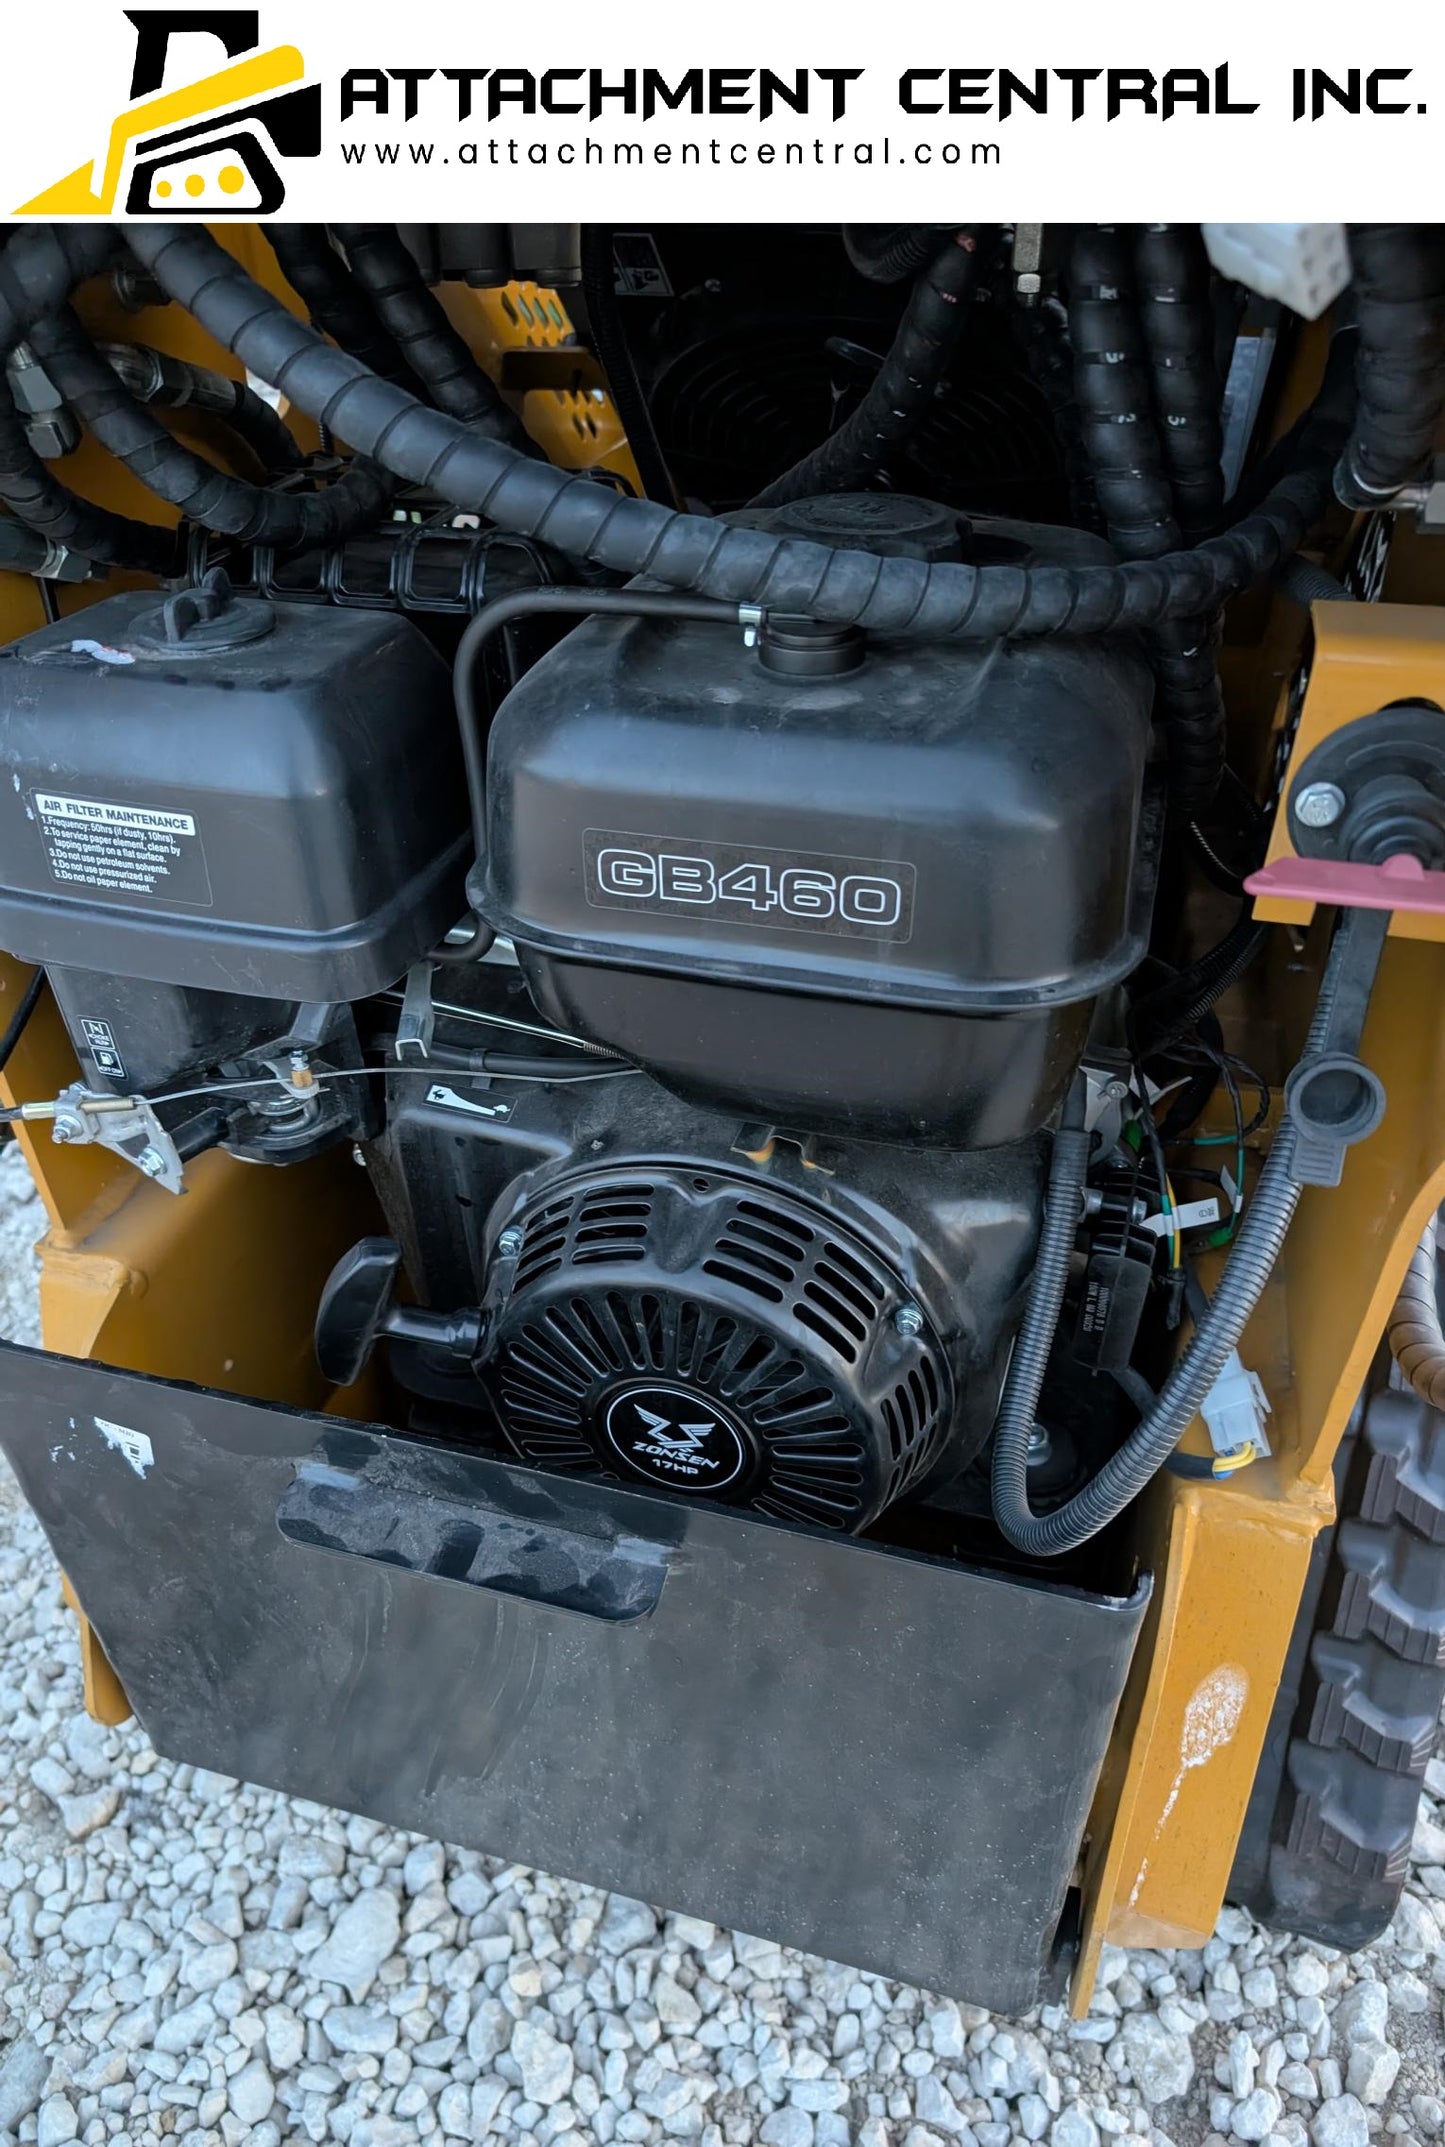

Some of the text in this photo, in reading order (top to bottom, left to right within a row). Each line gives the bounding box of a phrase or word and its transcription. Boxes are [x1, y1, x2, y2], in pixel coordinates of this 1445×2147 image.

[44, 800, 189, 830] AIR FILTER MAINTENANCE
[91, 823, 113, 835] 50hrs
[54, 837, 82, 852] tapping
[82, 843, 105, 856] gently
[105, 847, 116, 856] on
[116, 849, 122, 857] a
[122, 848, 136, 859] flat
[61, 830, 89, 842] service
[90, 834, 112, 846] paper
[148, 842, 169, 853] clean
[170, 845, 181, 857] by
[68, 852, 81, 861] not
[81, 854, 96, 863] use
[96, 856, 135, 869] petroleum
[70, 863, 83, 872] not
[84, 865, 98, 874] use
[98, 867, 143, 881] pressurized
[73, 873, 86, 882] not
[86, 874, 96, 883] oil
[97, 877, 118, 888] paper
[597, 848, 902, 926] GB460
[632, 1441, 720, 1469] ZONSEN
[652, 1458, 699, 1475] 17HP
